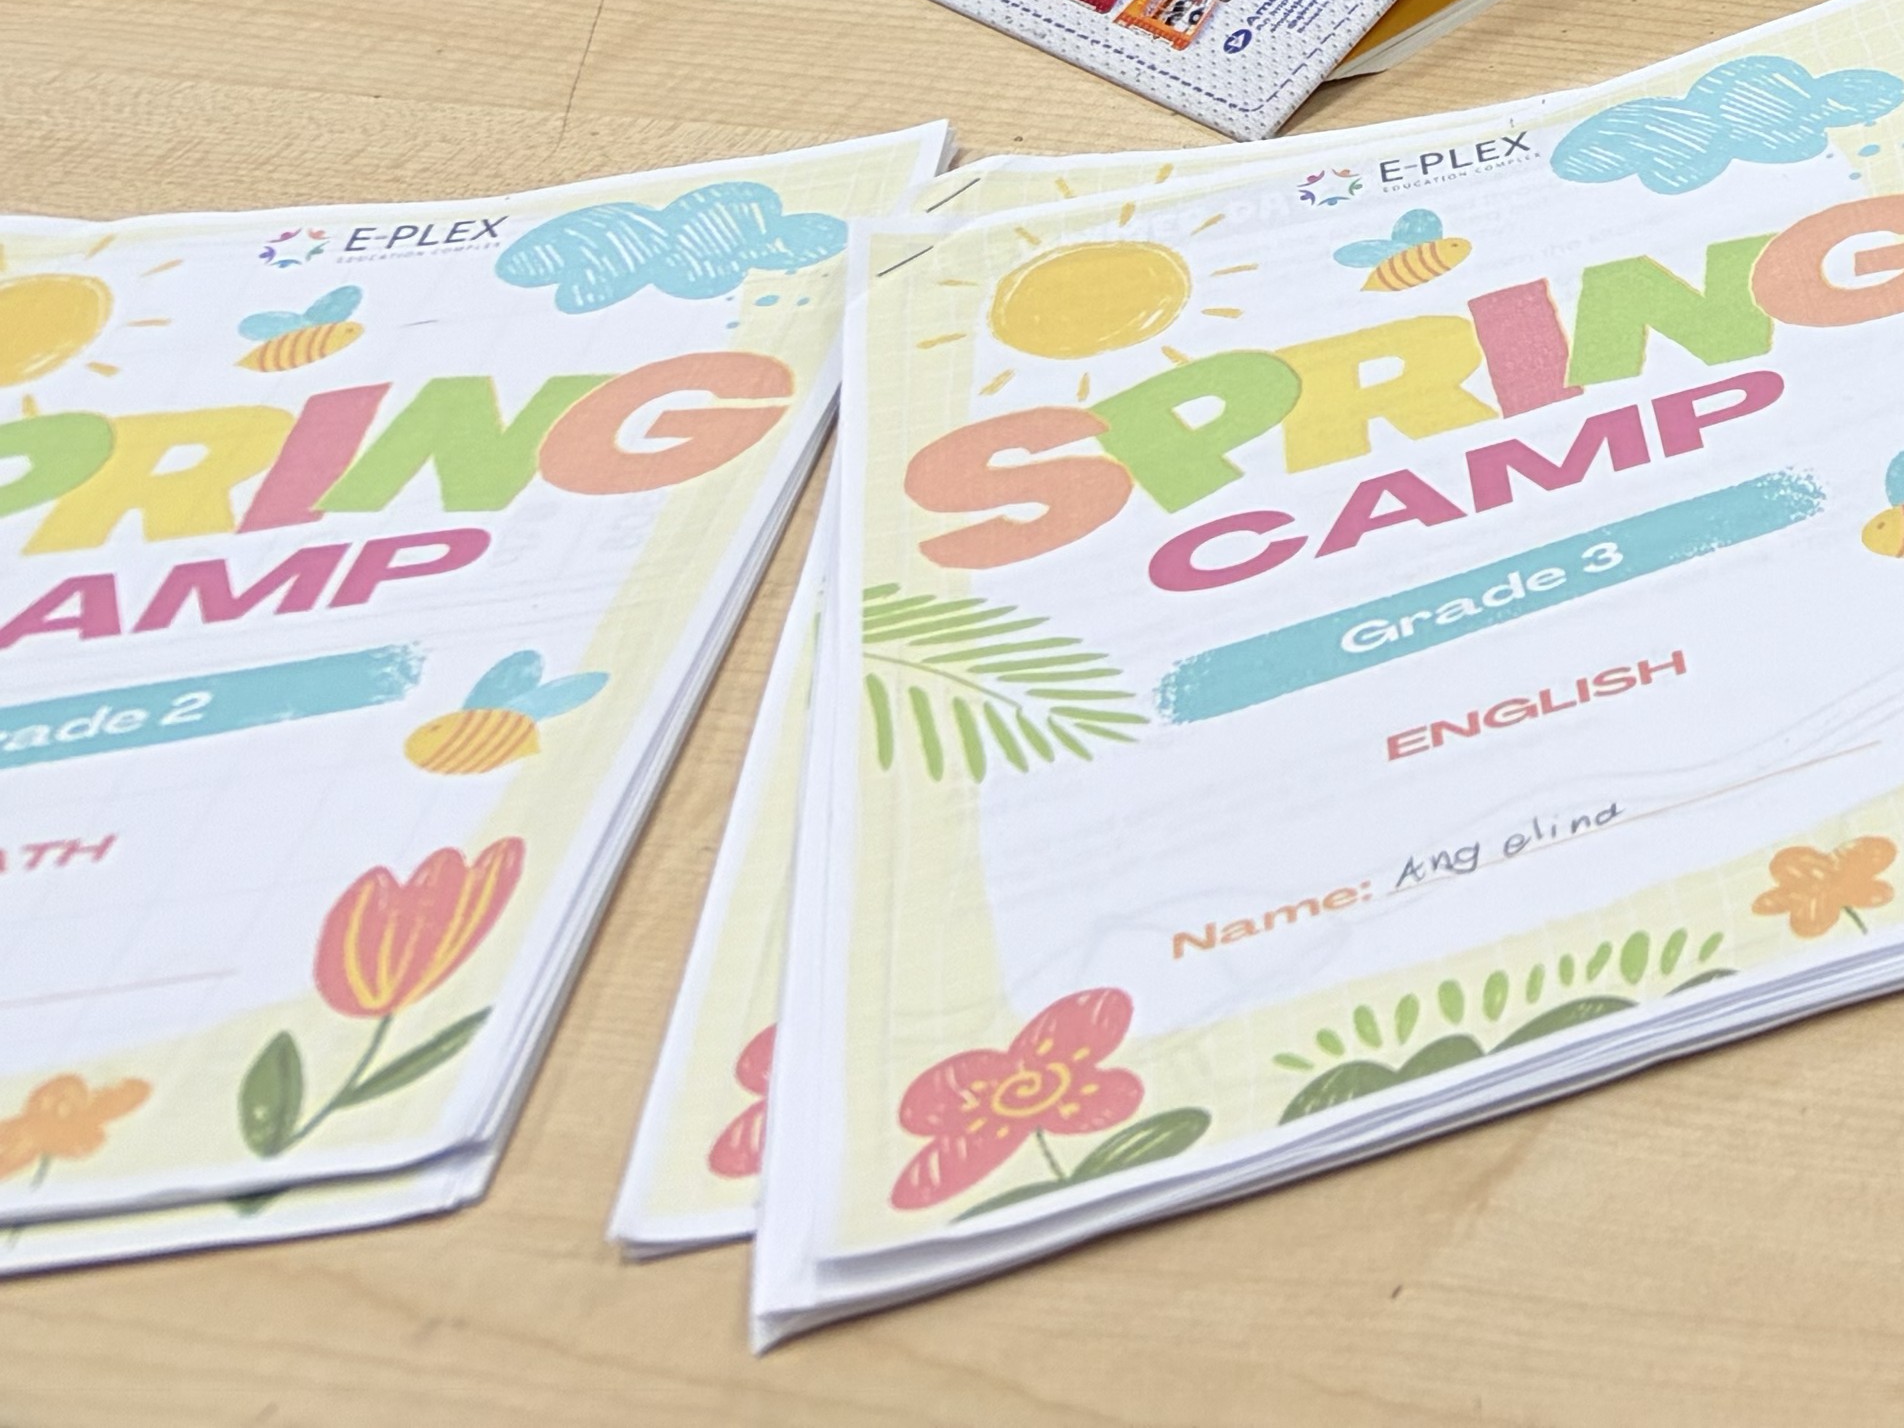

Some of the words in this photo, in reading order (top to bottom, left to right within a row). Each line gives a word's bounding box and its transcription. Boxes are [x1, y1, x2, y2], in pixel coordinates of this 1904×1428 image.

[1379, 130, 1531, 183] E-PLEX
[1383, 170, 1467, 193] EDUCATION
[344, 215, 509, 252] E-PLEX
[1146, 369, 1788, 594] CAMP
[0, 527, 490, 650] AMP
[1340, 557, 1570, 659] Grade
[1577, 539, 1626, 581] 3
[159, 690, 214, 726] 2
[1385, 649, 1688, 764] ENGLISH
[1173, 879, 1372, 960] Name:
